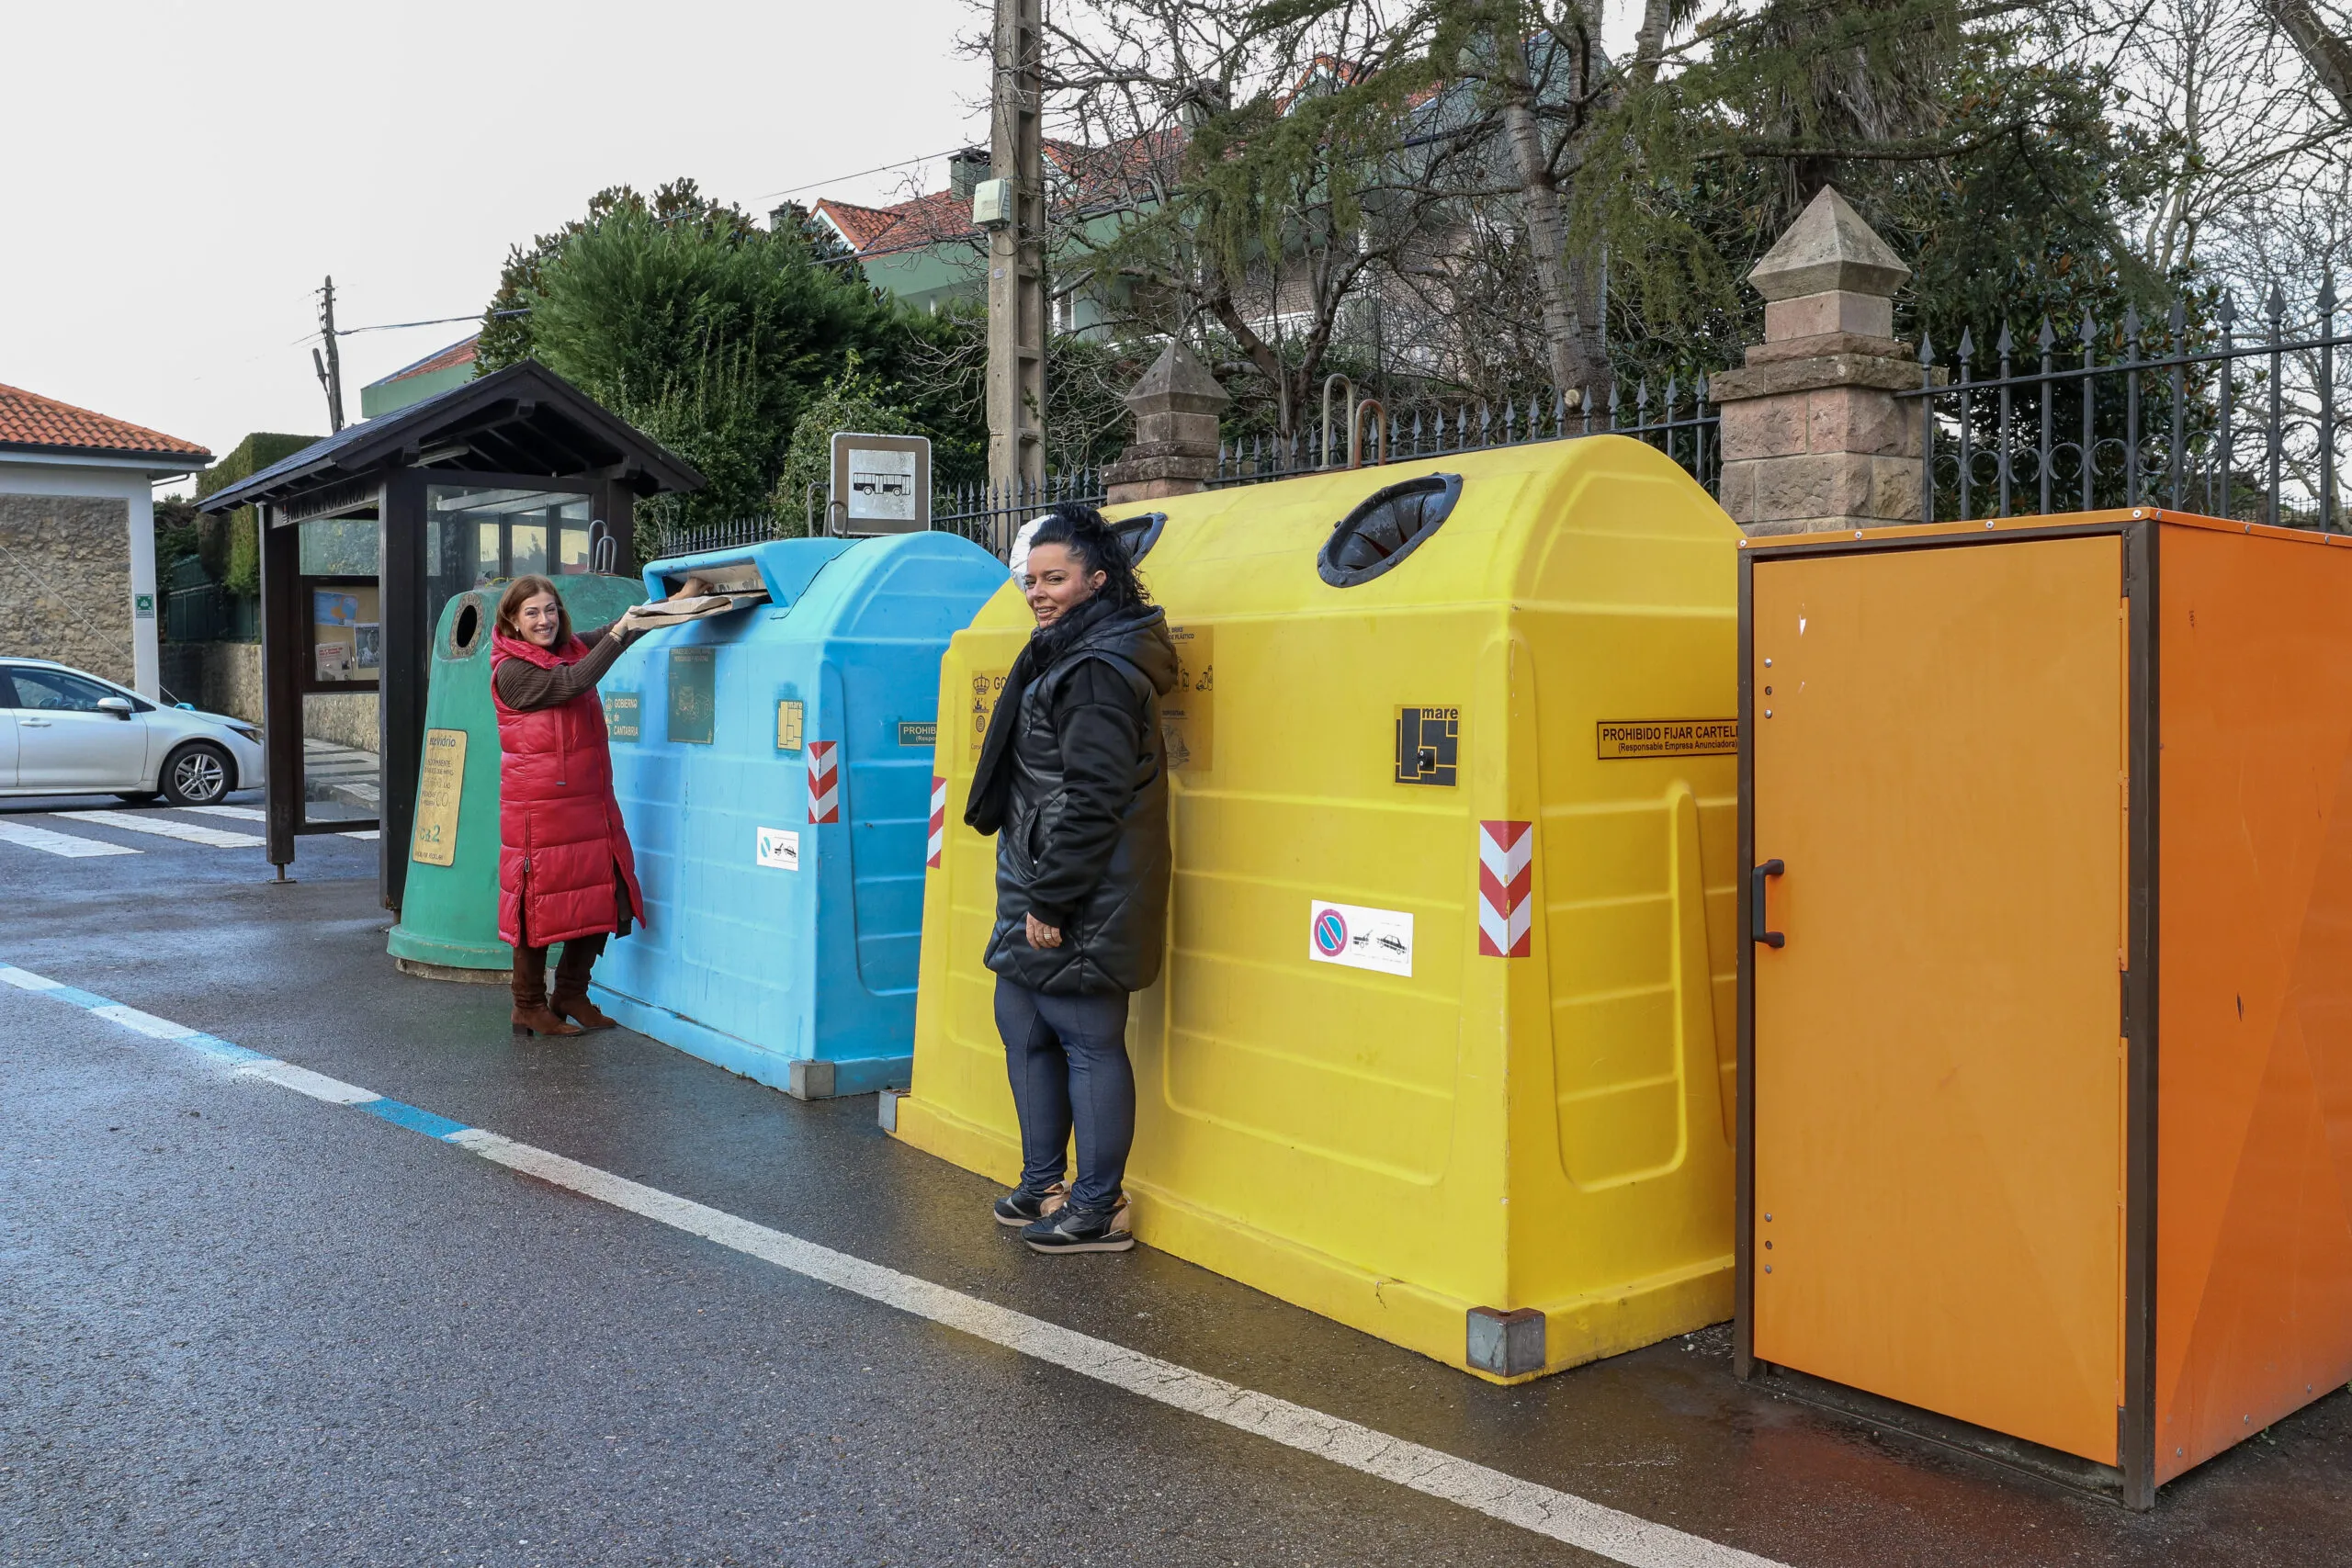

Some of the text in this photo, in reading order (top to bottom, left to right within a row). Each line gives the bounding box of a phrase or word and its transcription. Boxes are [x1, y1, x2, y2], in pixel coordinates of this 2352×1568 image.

[615, 699, 638, 708] GOBIERNO
[1422, 707, 1459, 719] mare
[614, 726, 639, 736] CANTABRIA
[903, 727, 936, 735] PROHIB
[1602, 726, 1738, 741] PROHIBIDO FIJAR CARTEL
[1618, 739, 1737, 753] (Responsable Empresa Anunciadora)
